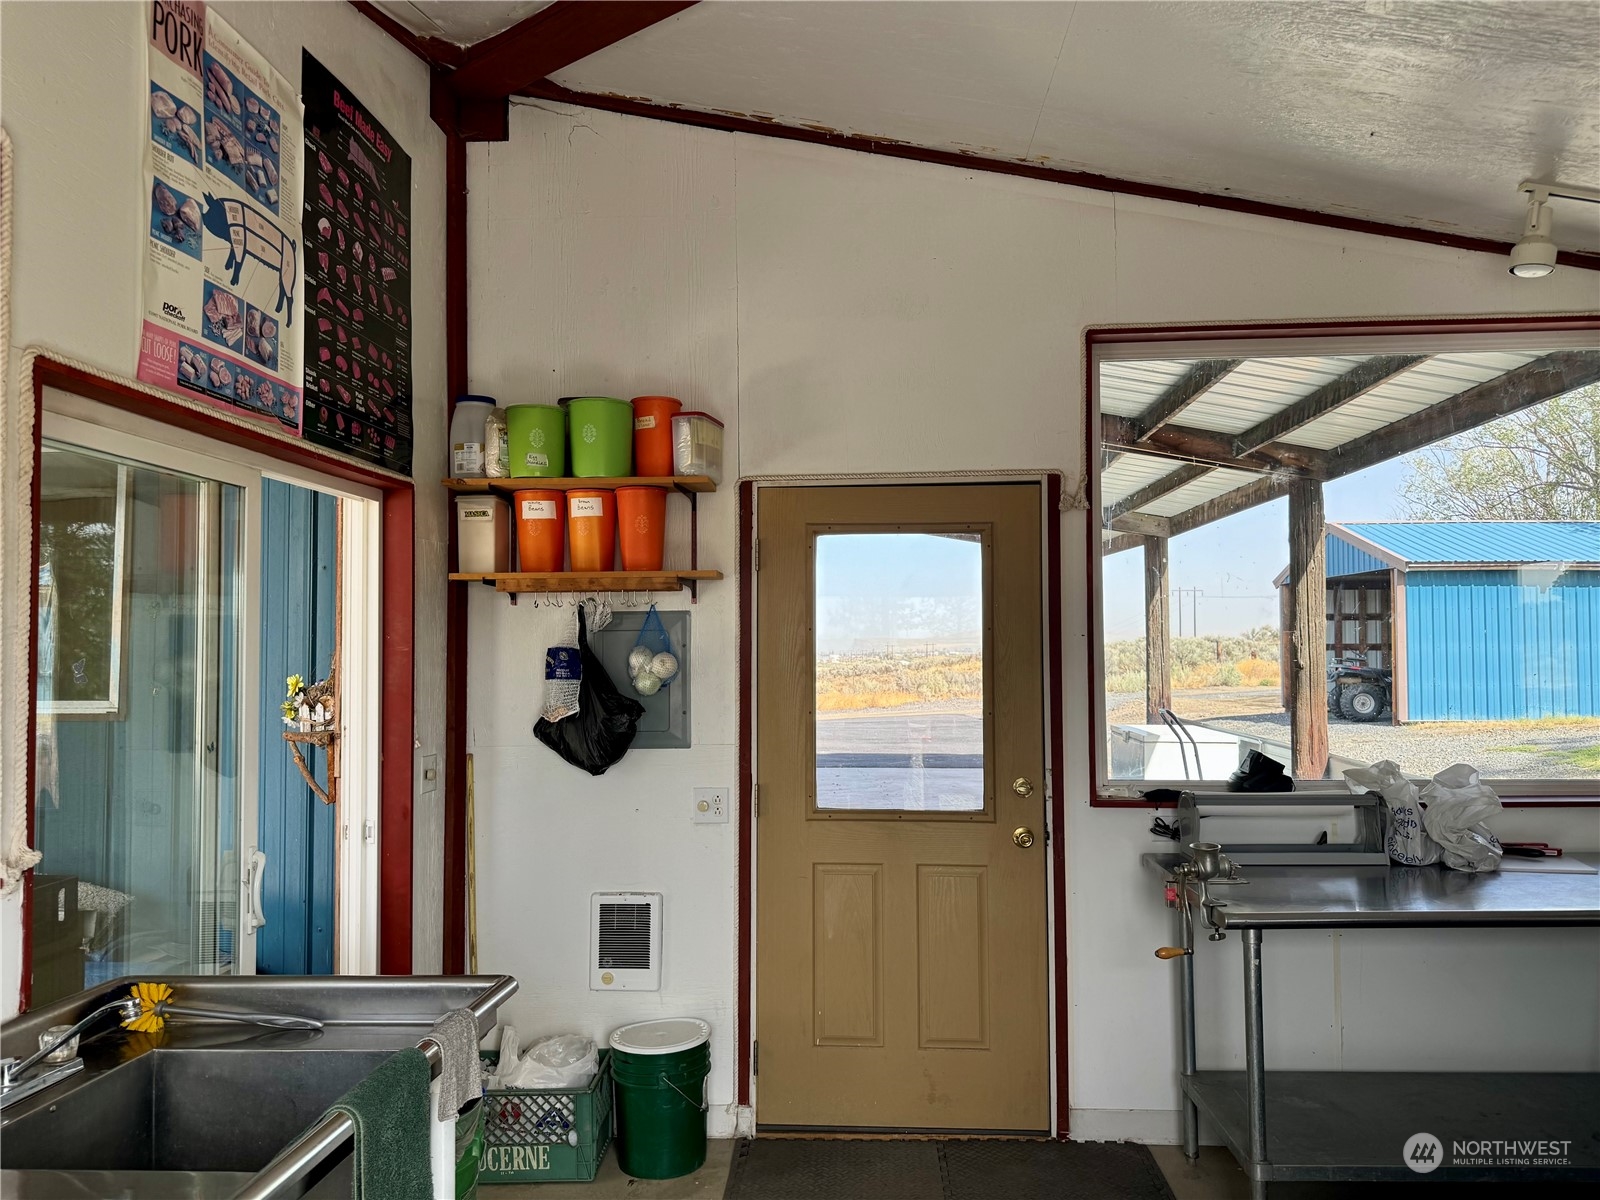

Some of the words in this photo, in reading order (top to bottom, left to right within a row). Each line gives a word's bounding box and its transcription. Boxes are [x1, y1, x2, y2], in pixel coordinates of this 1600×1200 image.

[153, 0, 203, 77] PORK
[333, 89, 353, 121] Beef
[355, 110, 375, 143] Made
[376, 132, 393, 163] Easy
[153, 340, 177, 364] LOOSE!
[480, 1146, 550, 1172] UCERNE
